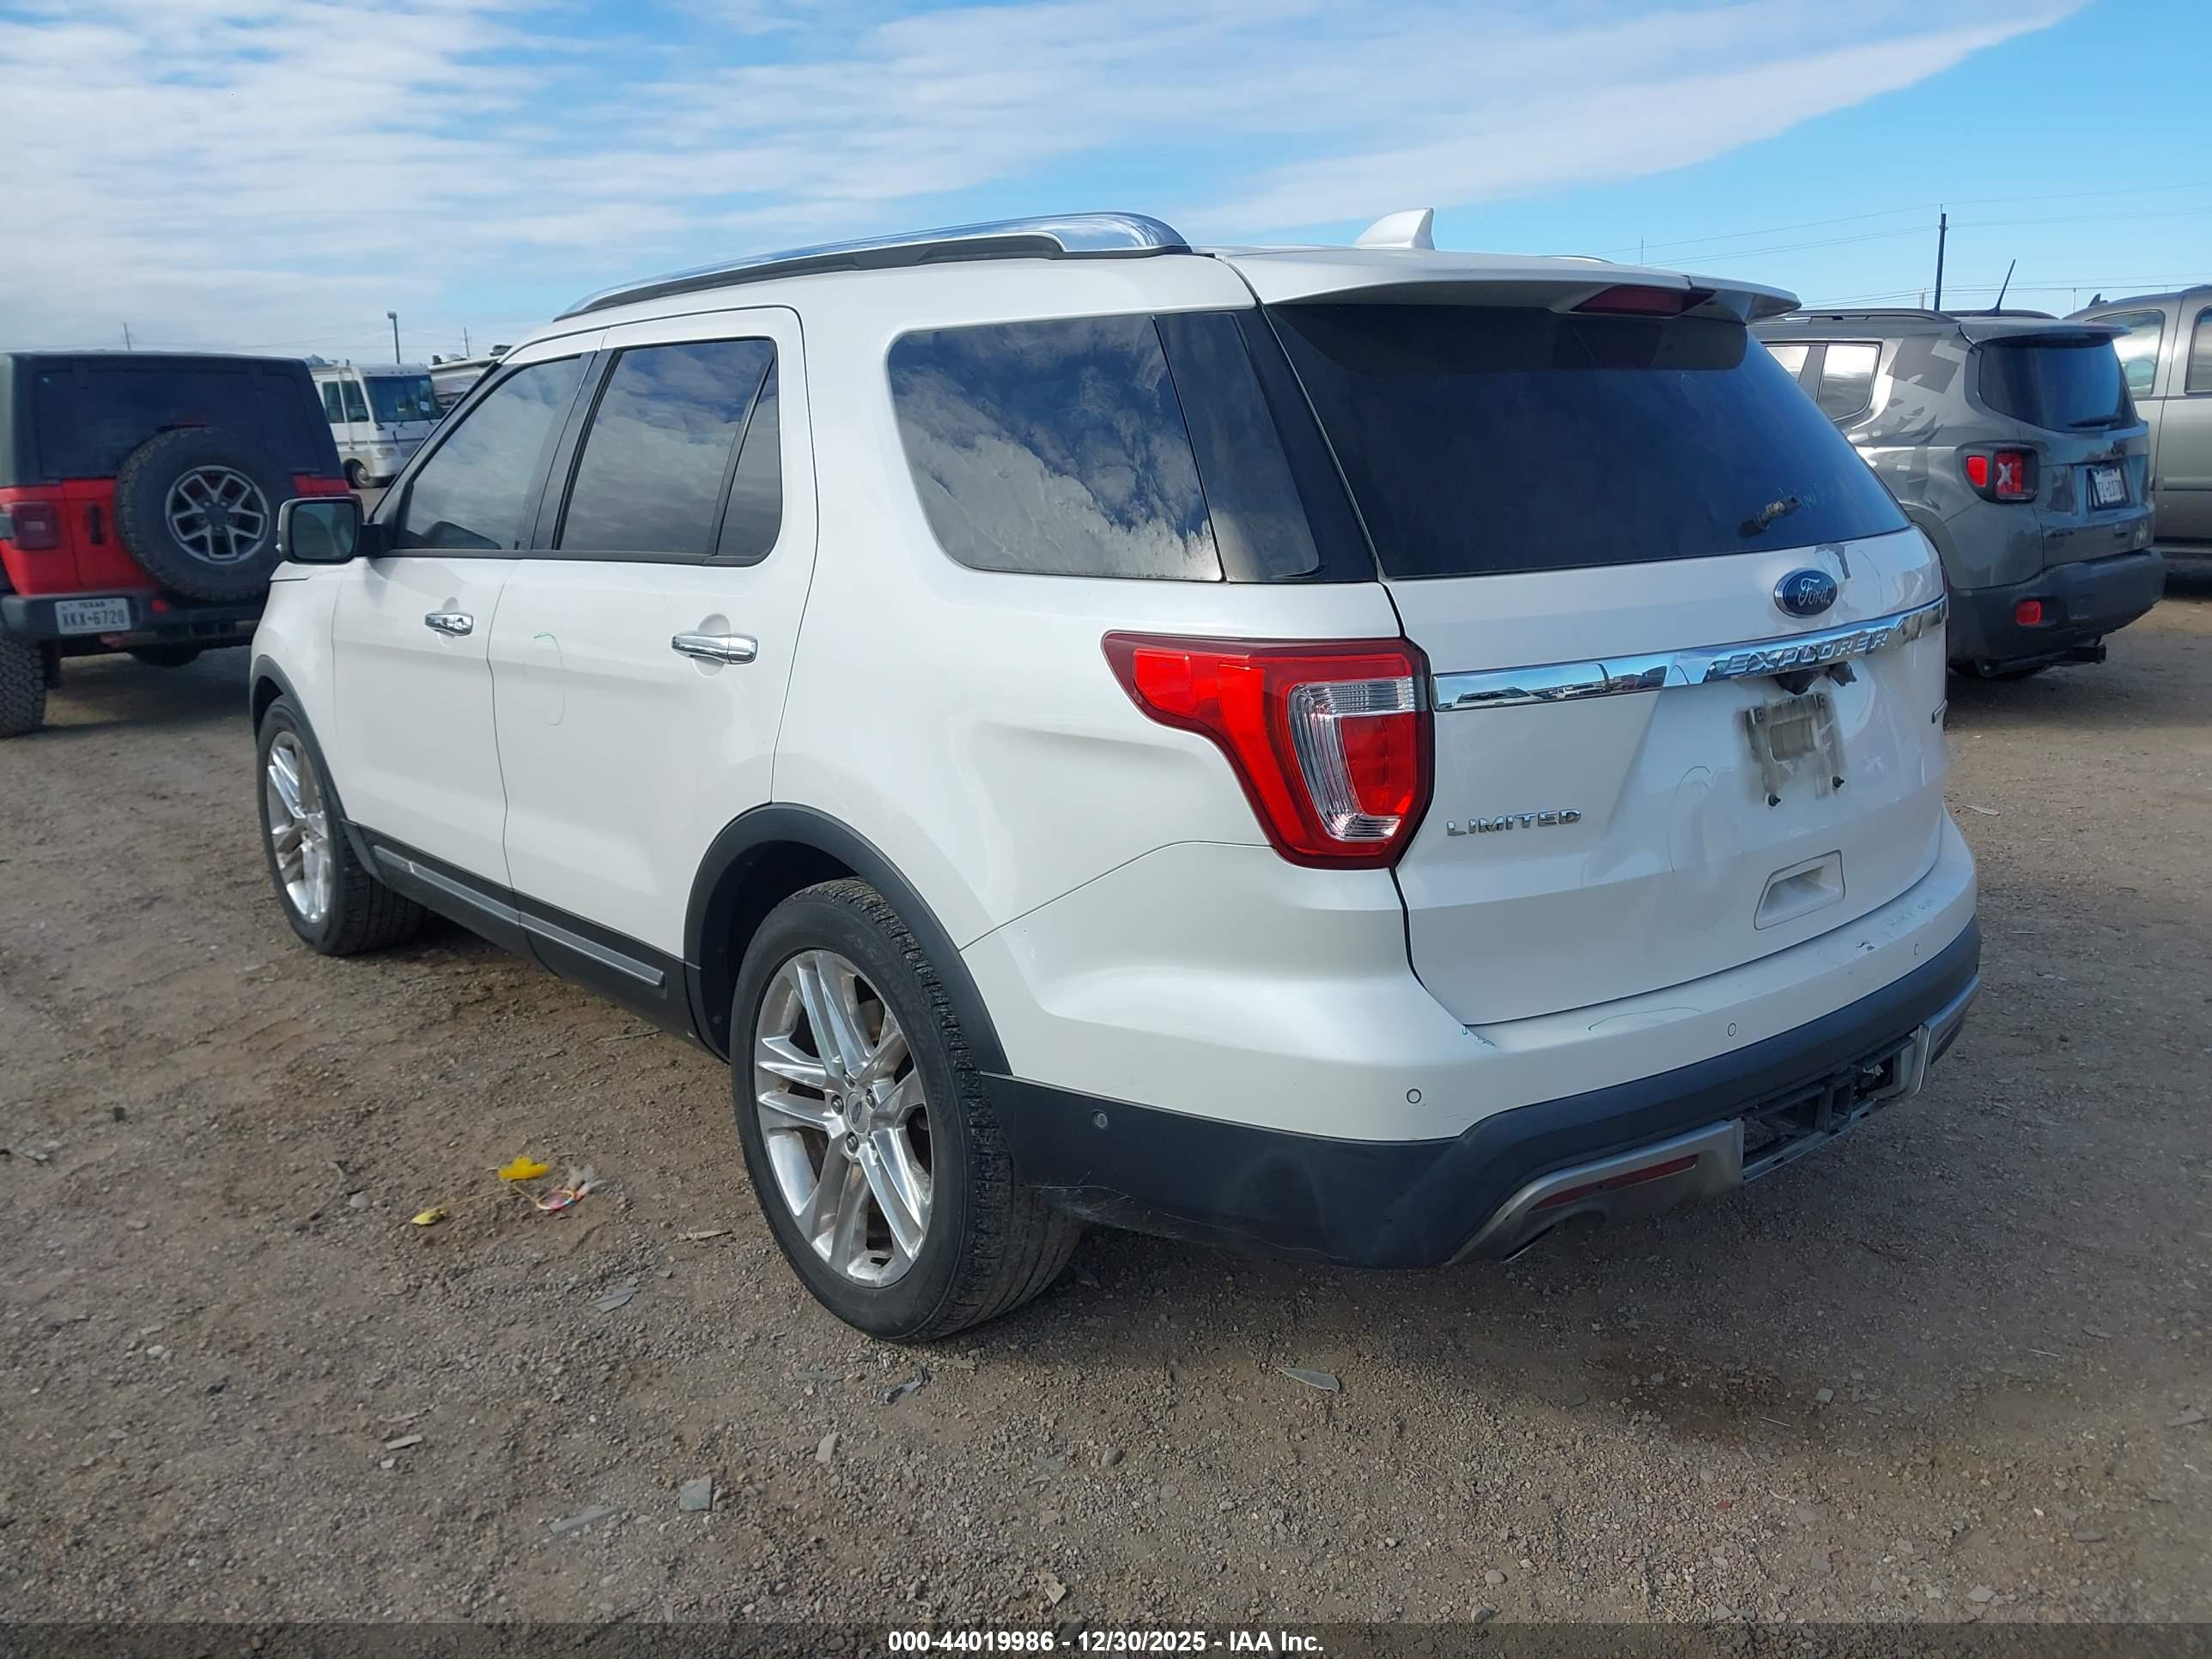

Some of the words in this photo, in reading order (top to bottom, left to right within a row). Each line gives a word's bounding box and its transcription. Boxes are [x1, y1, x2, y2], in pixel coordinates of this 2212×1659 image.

[1797, 577, 1829, 606] Ford
[1724, 633, 1888, 674] EXPLORER
[1446, 808, 1582, 836] LIMITED
